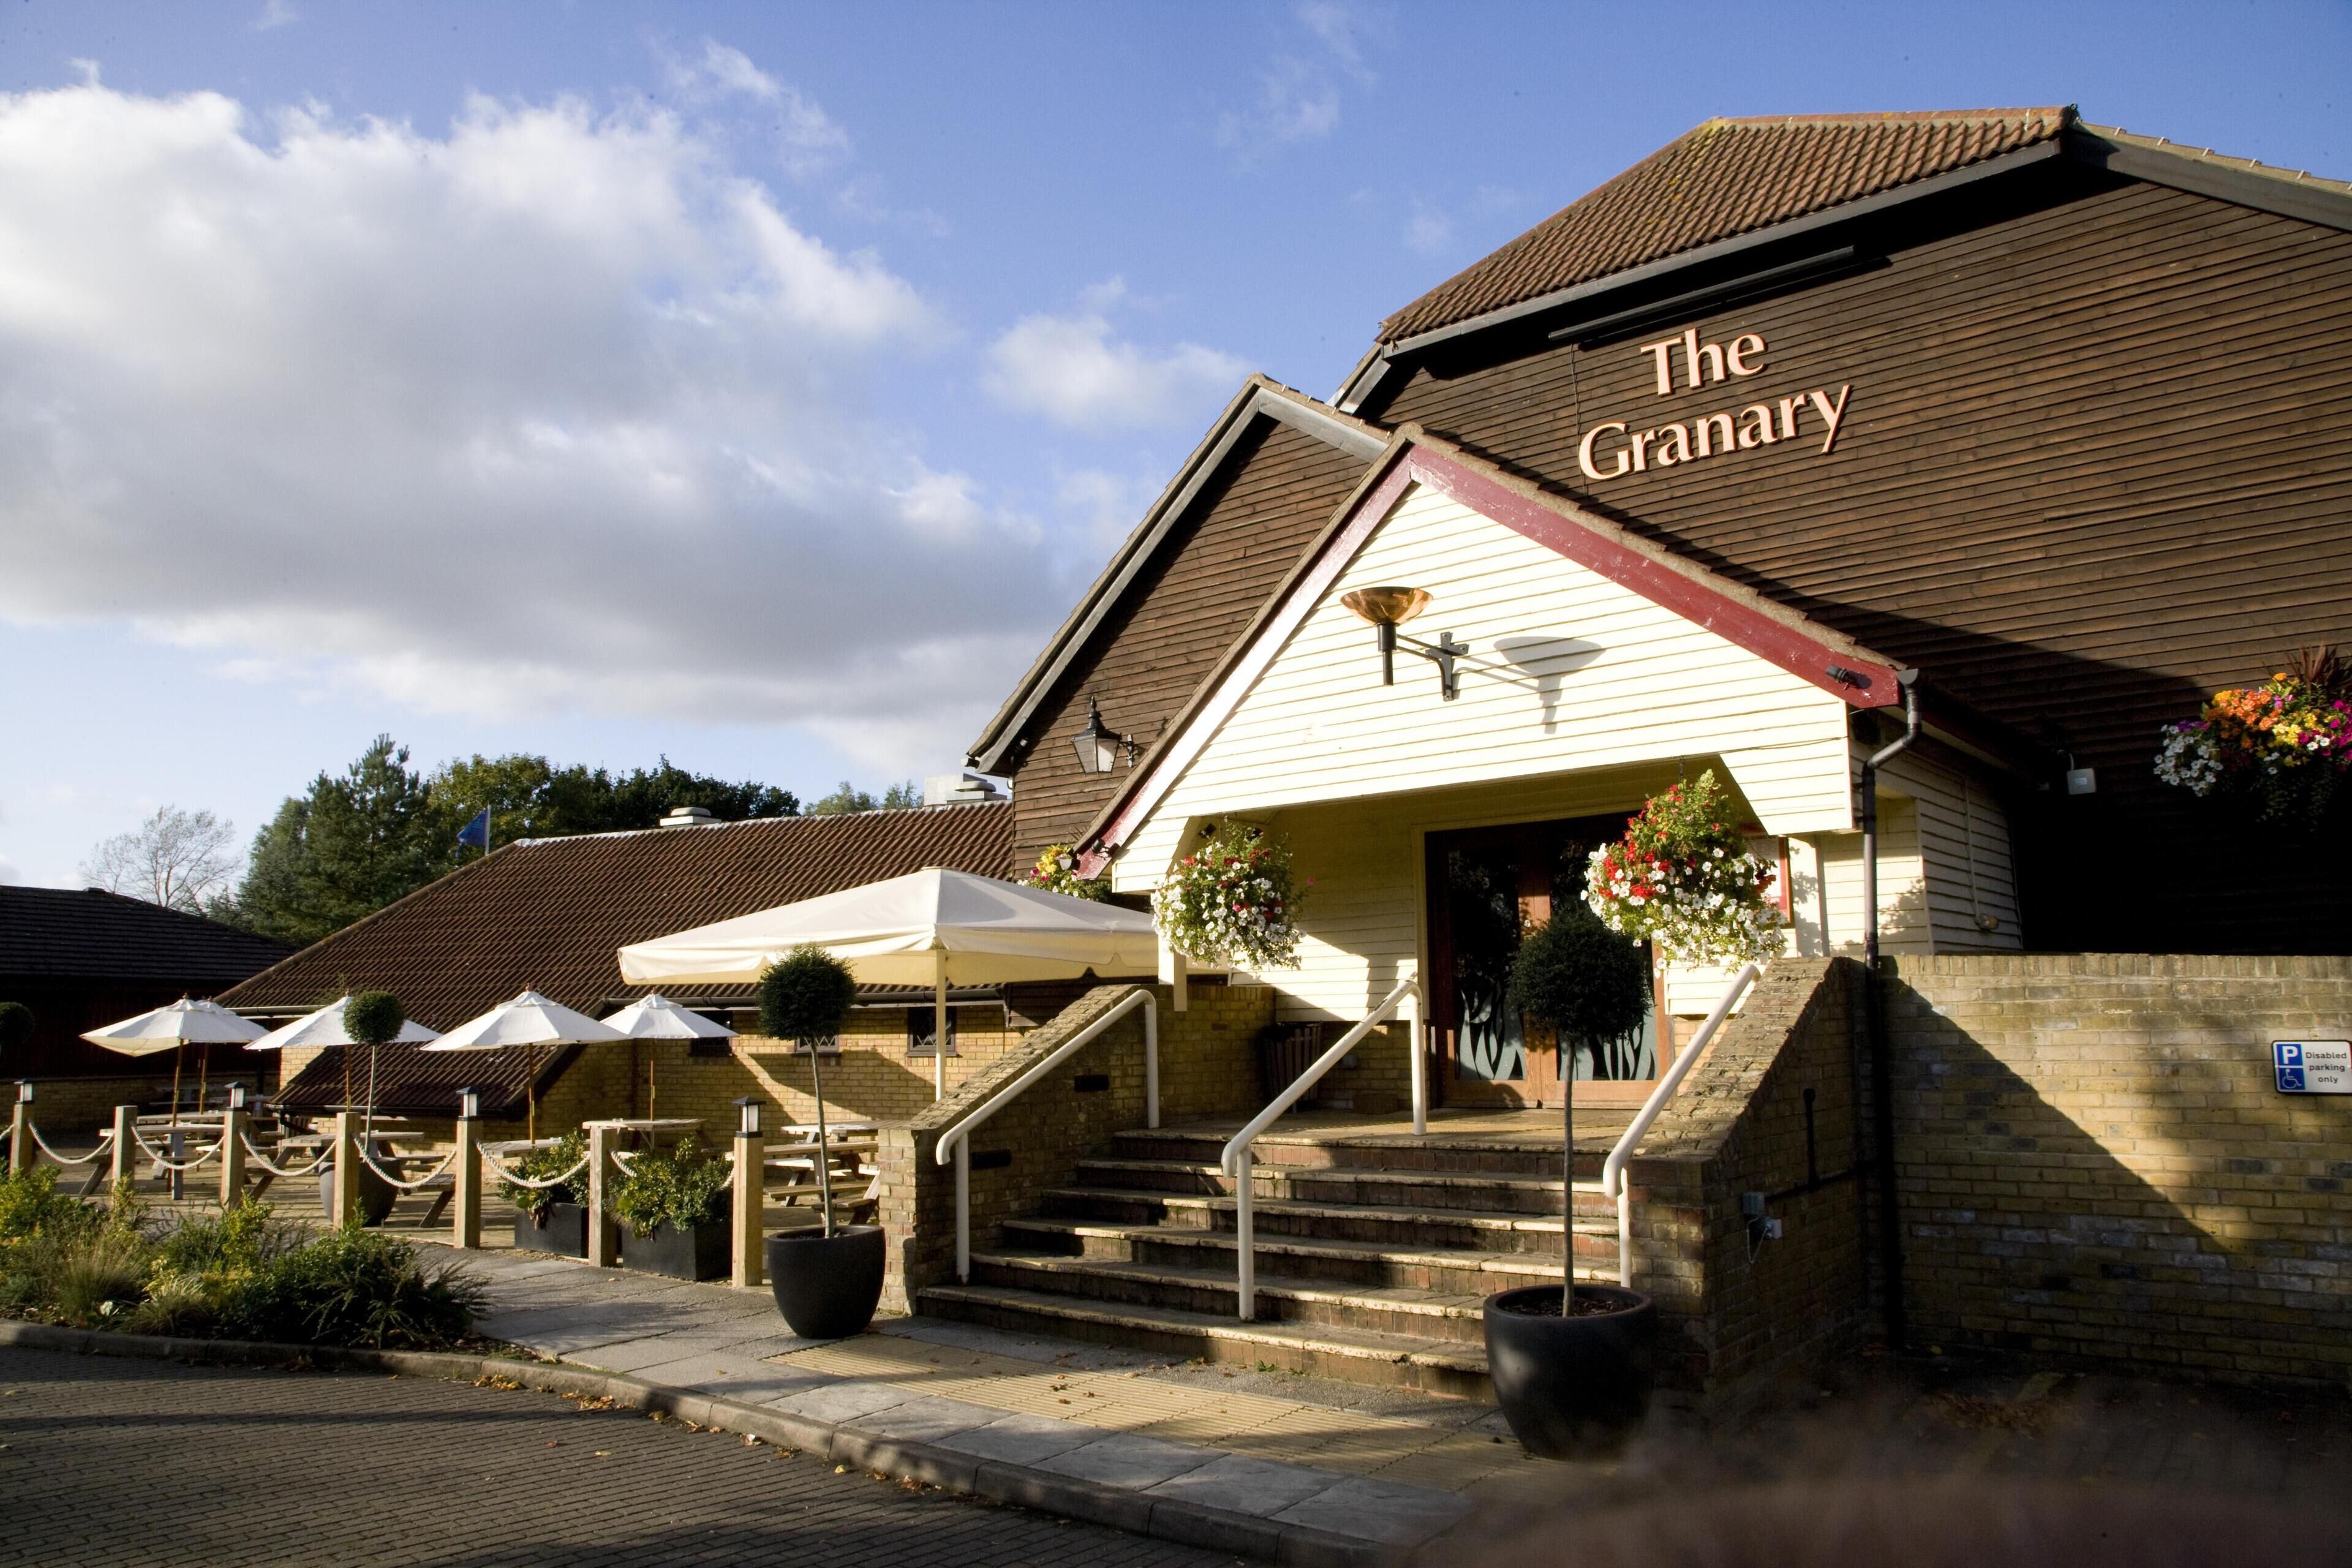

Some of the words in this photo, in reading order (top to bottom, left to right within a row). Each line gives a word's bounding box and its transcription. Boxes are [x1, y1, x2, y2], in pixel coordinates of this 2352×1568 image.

[1640, 328, 1766, 396] The
[1578, 383, 1850, 480] Granary
[2282, 1046, 2298, 1064] P
